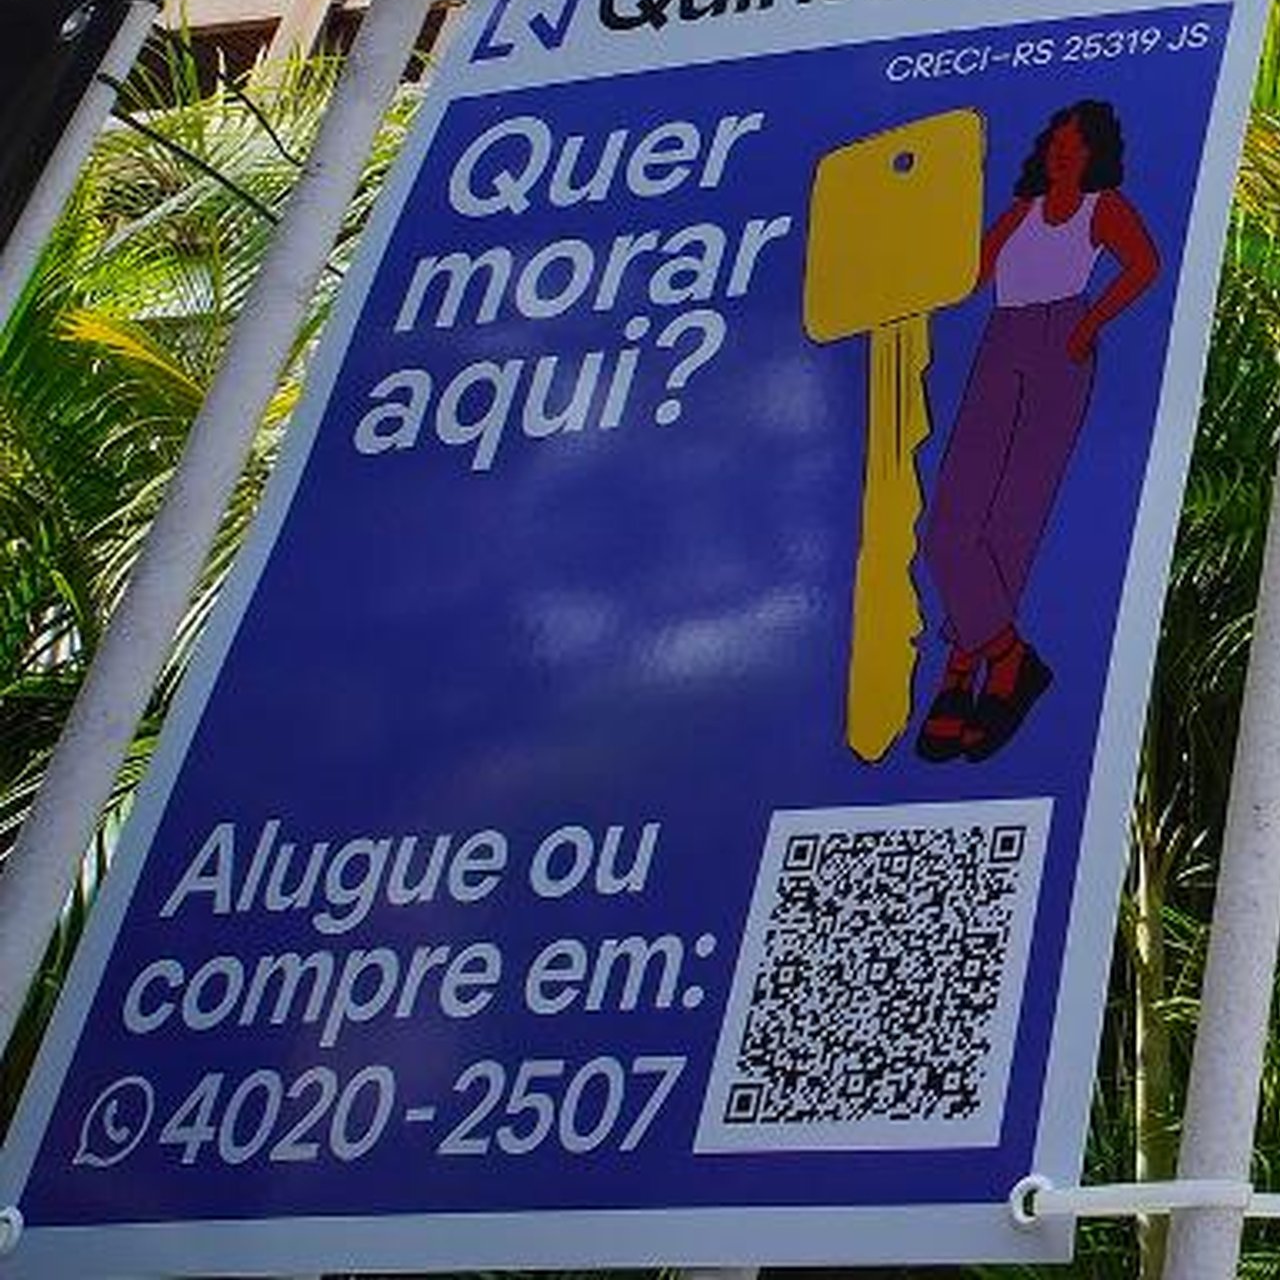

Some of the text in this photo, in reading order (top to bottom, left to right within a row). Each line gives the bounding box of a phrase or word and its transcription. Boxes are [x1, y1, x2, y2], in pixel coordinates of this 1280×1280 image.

[1061, 25, 1162, 63] 25319
[1166, 21, 1211, 52] JS
[448, 111, 765, 218] Quer
[393, 215, 792, 333] morar
[353, 308, 728, 472] aqui?
[158, 819, 661, 935] Alugue ou
[122, 931, 717, 1048] compre em:
[158, 1054, 688, 1166] 4020-2507
